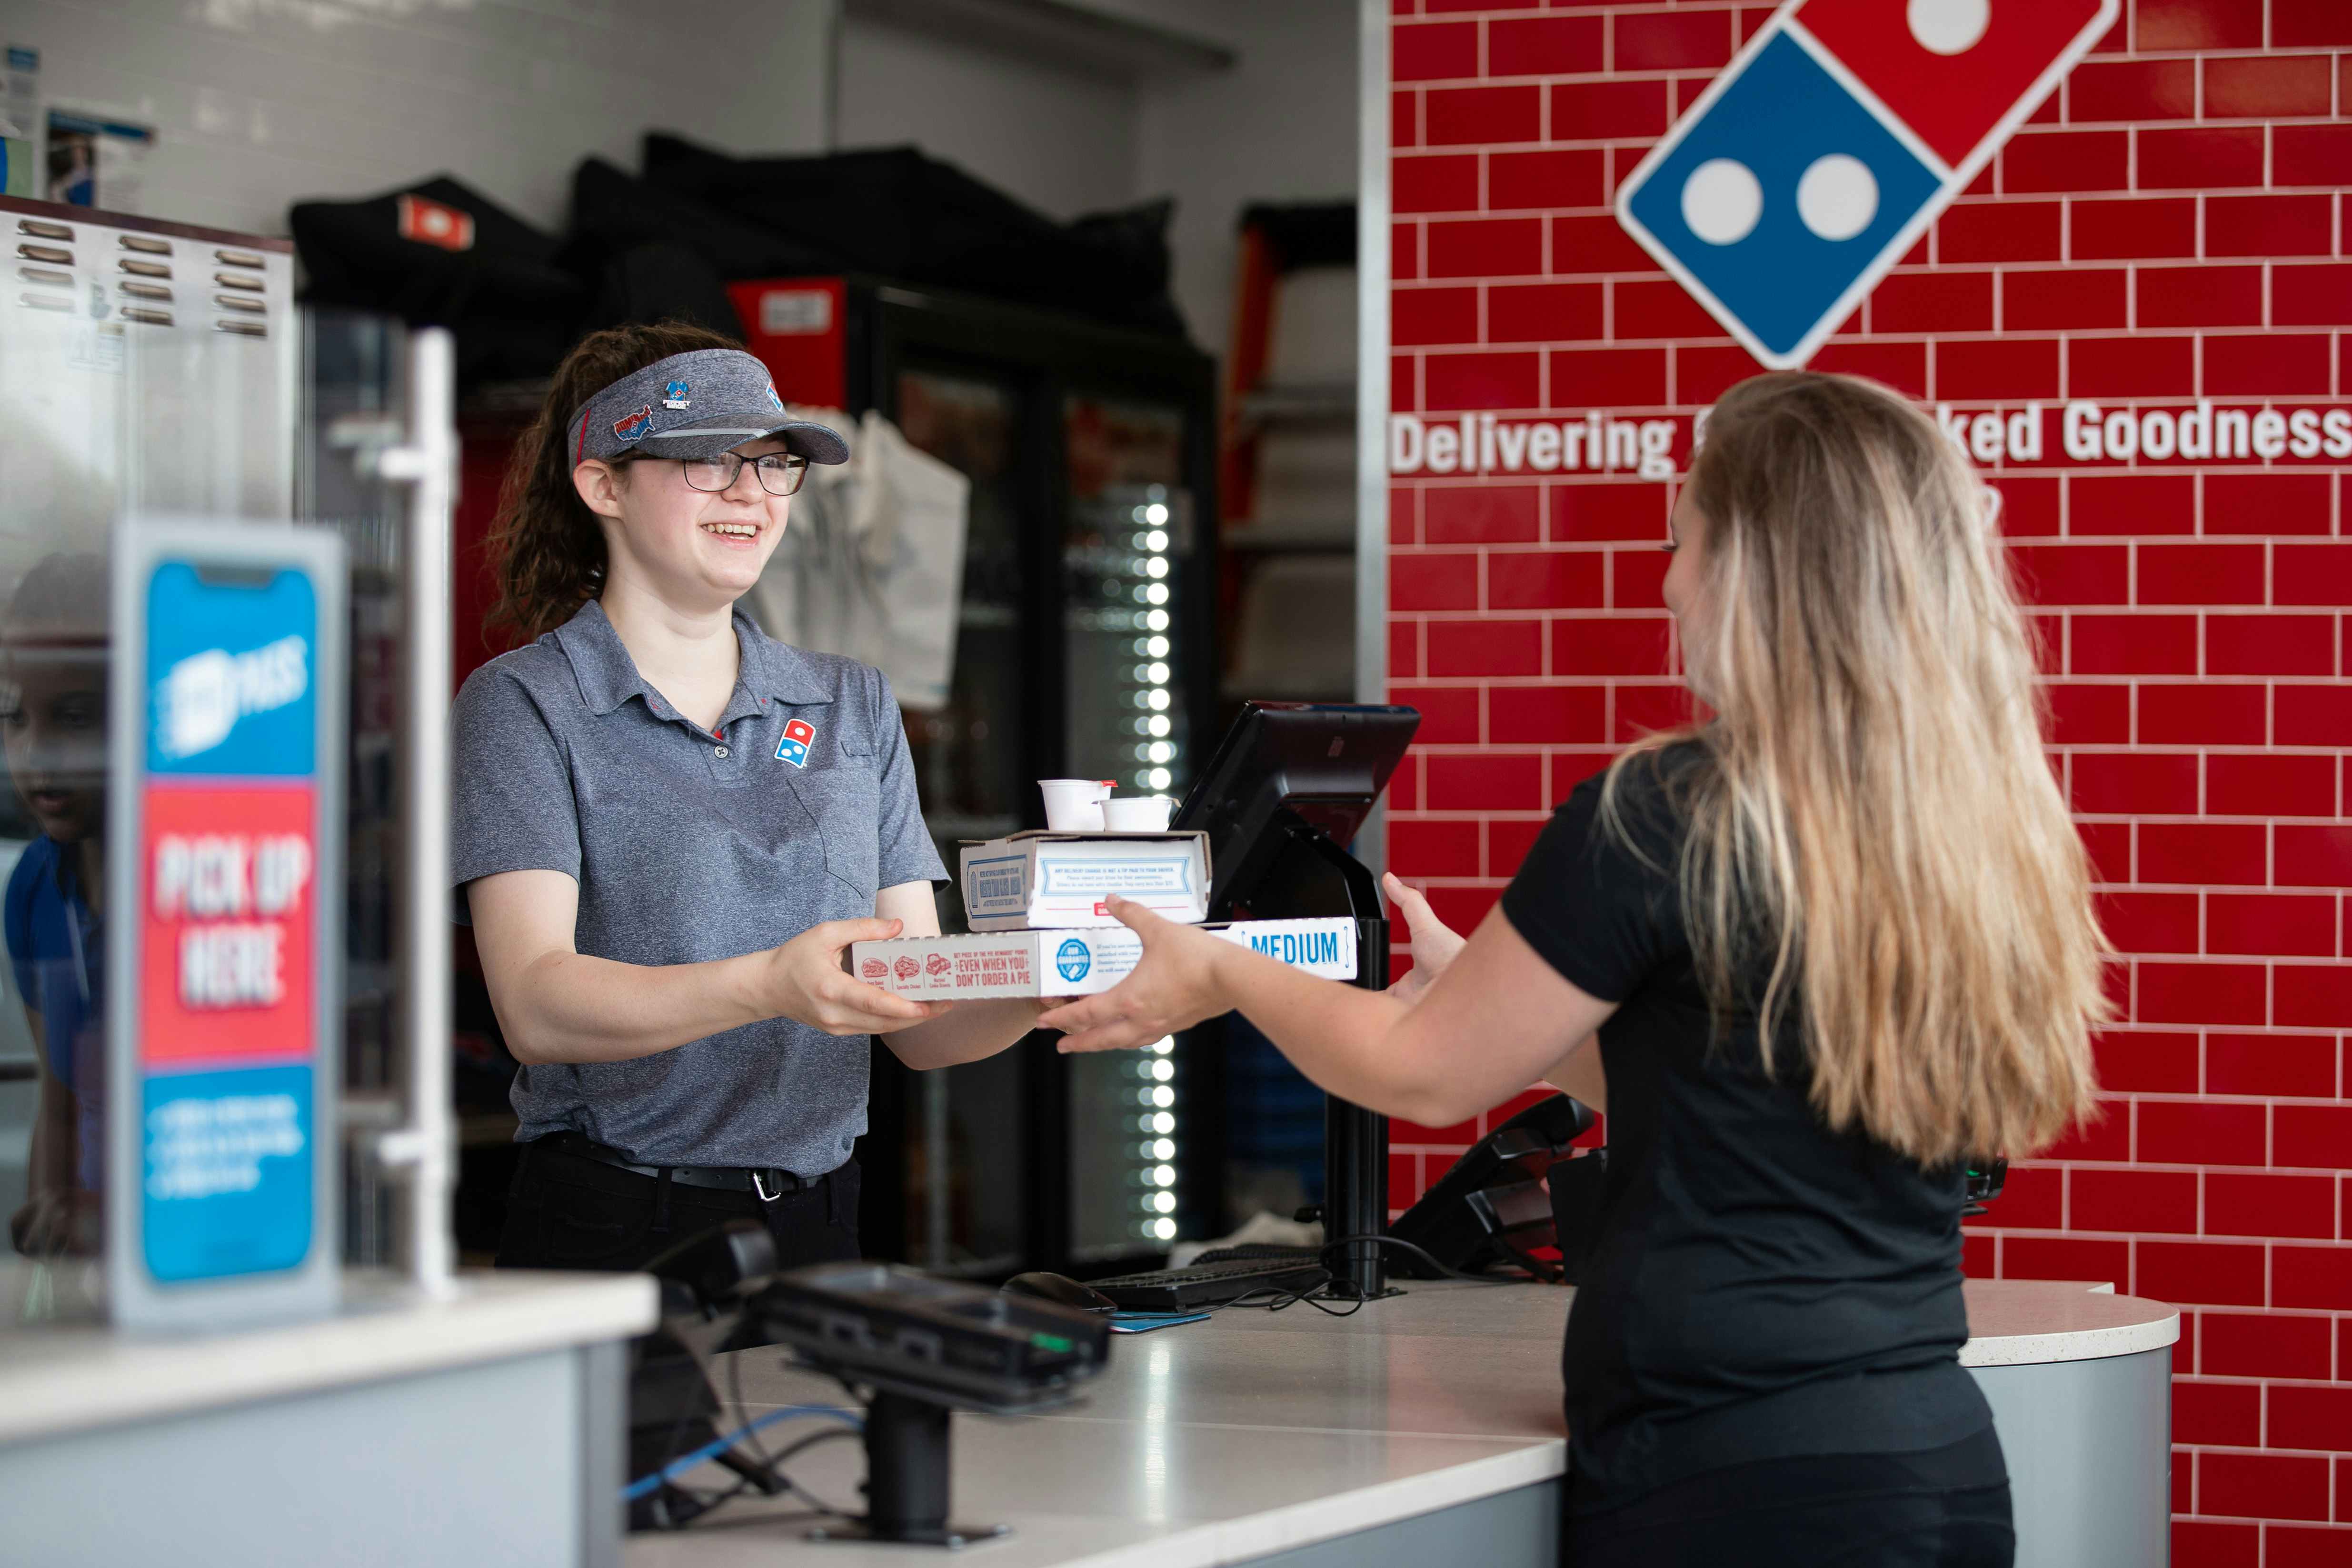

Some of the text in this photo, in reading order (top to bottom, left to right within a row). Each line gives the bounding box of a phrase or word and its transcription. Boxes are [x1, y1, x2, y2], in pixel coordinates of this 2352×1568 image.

[1390, 410, 1677, 480] Delivering
[2063, 398, 2352, 460] Goodness
[155, 832, 312, 920] PICK UP
[178, 921, 287, 1007] HERE
[957, 971, 1031, 987] DON'T ORDER A PIE
[959, 957, 1024, 972] EVEN WHEN YOU
